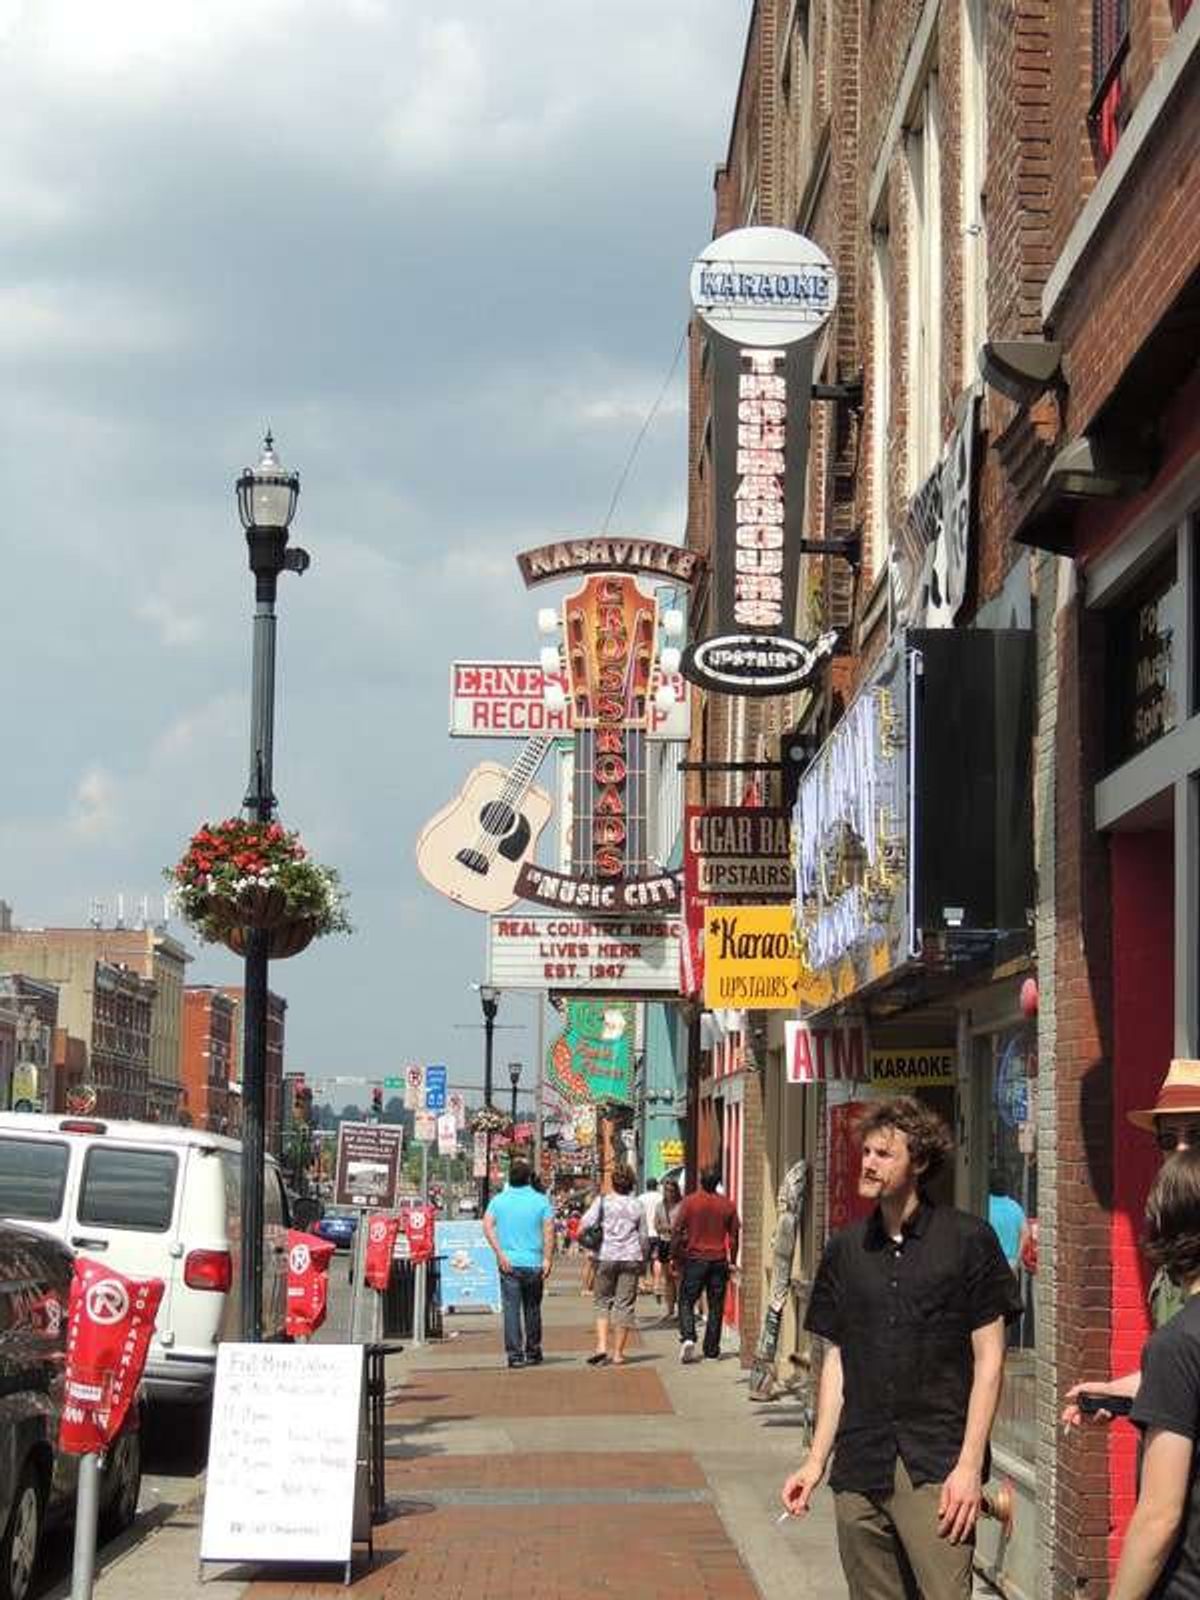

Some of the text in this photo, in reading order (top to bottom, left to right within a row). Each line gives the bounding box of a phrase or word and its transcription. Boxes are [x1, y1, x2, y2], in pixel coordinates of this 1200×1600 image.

[700, 271, 830, 300] KARAOKE
[528, 541, 696, 583] NASHVILLE
[596, 575, 627, 876] CROSSROADS
[690, 815, 789, 853] CIGAR BA
[703, 863, 790, 886] UPSTAIRS
[498, 921, 681, 938] REAL COUNTRY MUSIC
[540, 943, 642, 959] LIVES HERE
[543, 963, 580, 978] EST.
[719, 976, 789, 998] UPSTAIRS
[792, 1027, 869, 1081] ATM
[873, 1055, 952, 1079] KARAOKE
[112, 1286, 149, 1406] NO PARKING
